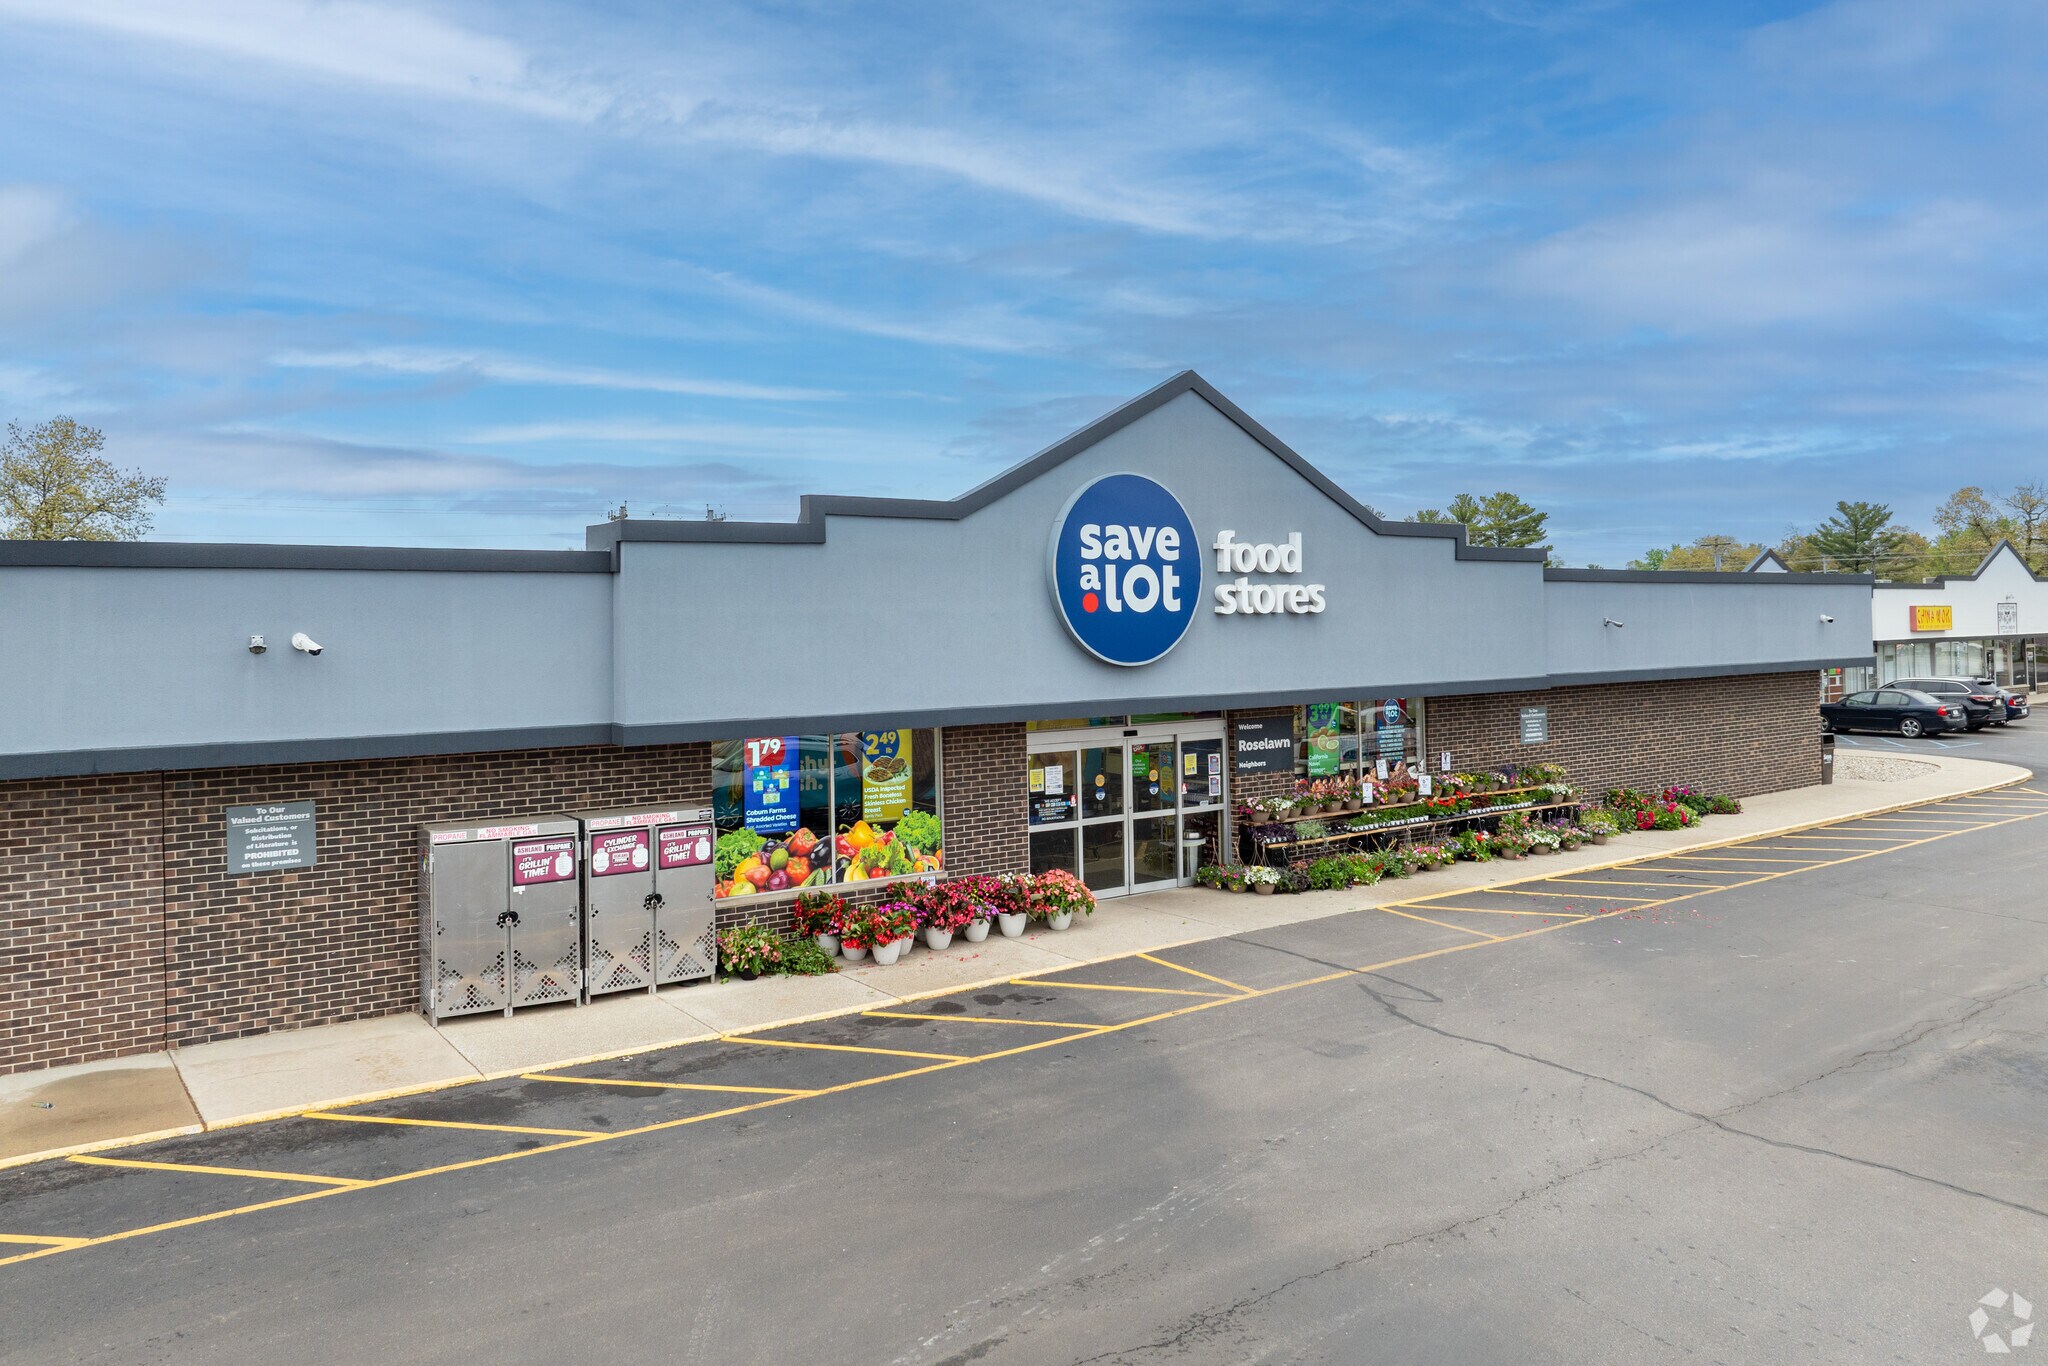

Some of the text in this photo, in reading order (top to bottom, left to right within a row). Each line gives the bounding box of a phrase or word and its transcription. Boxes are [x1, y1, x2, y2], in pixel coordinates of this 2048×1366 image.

[1080, 523, 1180, 561] save
[1213, 529, 1303, 573] food
[1080, 565, 1101, 591] a
[1214, 576, 1326, 615] stores
[1917, 608, 1935, 624] CHINA
[1238, 738, 1291, 752] Roselawn
[1308, 753, 1329, 761] California
[1238, 760, 1267, 769] Neighbors
[880, 784, 906, 792] Inspected
[864, 799, 885, 807] Skinless
[256, 807, 267, 815] To
[642, 812, 671, 820] SMOKING
[231, 812, 310, 825] Valued Customers
[591, 818, 621, 827] PROPANE
[625, 817, 662, 826] FLAMMABLE
[746, 815, 775, 823] Shredded
[498, 825, 530, 833] SMOKING
[662, 828, 709, 839] ASHLAND PROPANE
[251, 833, 292, 841] Distribution
[433, 832, 466, 841] PROPANE
[479, 830, 520, 839] FLAMMABLE
[603, 834, 638, 848] CYLINDER
[255, 841, 289, 849] Literature
[517, 842, 572, 854] ASHLAND PROPANE
[607, 842, 636, 853] EXCHANGE
[664, 841, 693, 855] GRILLIN'
[244, 848, 299, 860] PROHIBITED
[667, 850, 691, 863] TIME!
[251, 860, 271, 868] these
[271, 858, 302, 867] premises
[518, 856, 553, 871] GRILLIN'
[522, 865, 549, 879] TIME!
